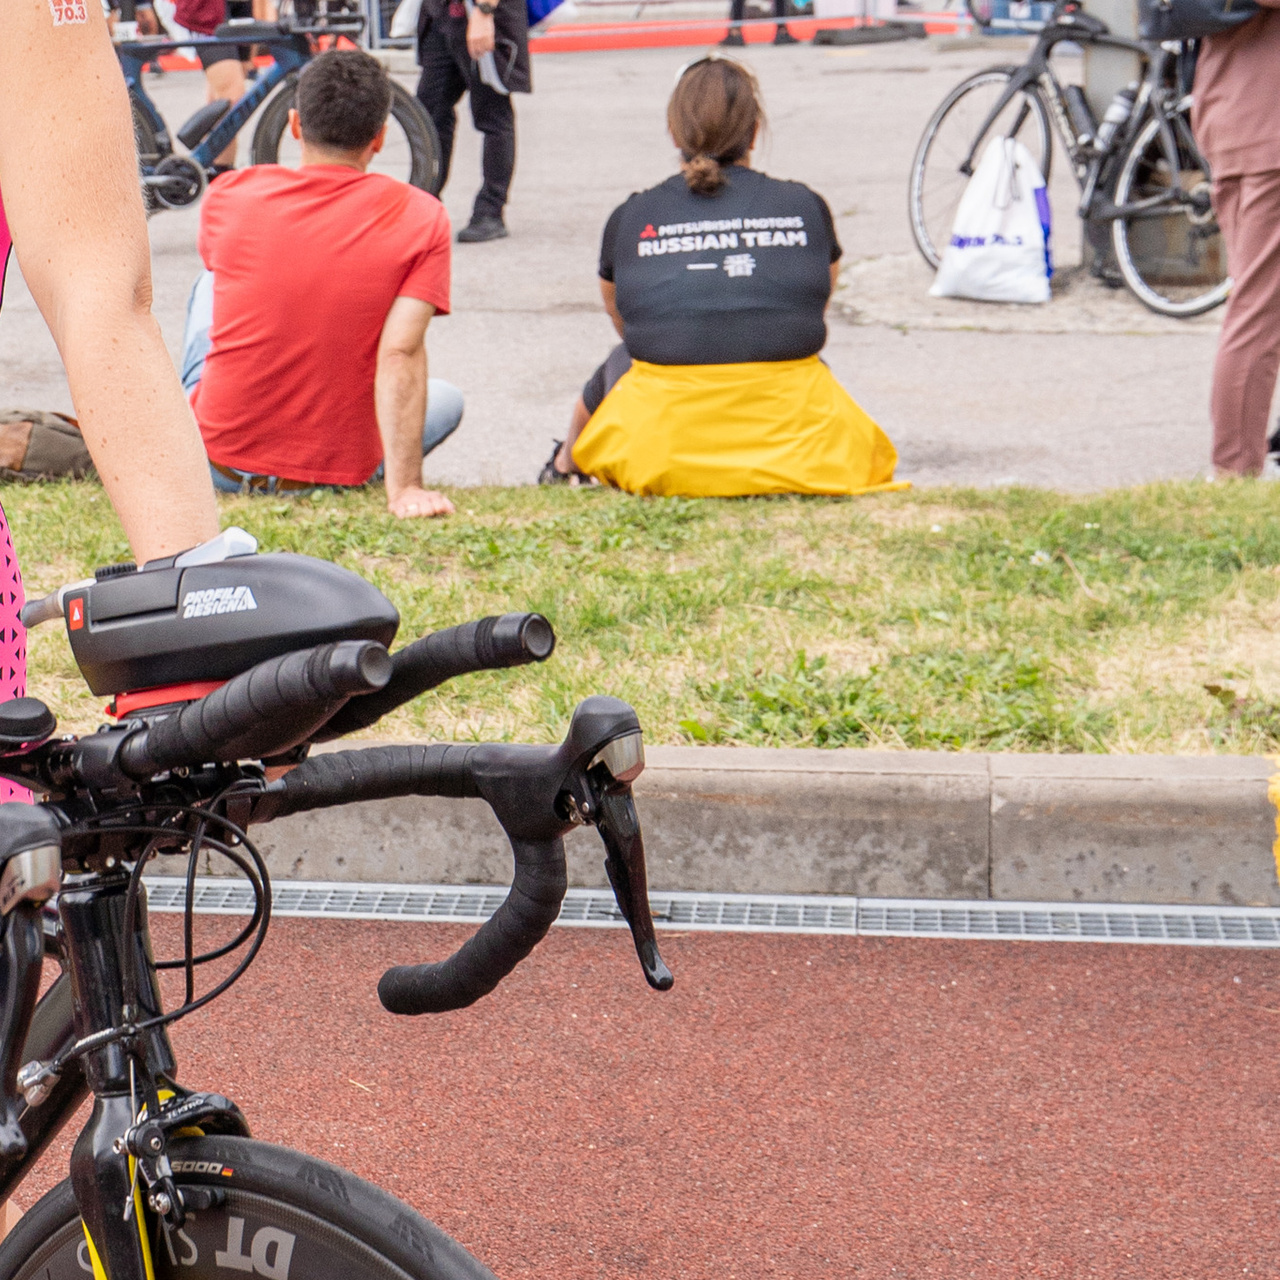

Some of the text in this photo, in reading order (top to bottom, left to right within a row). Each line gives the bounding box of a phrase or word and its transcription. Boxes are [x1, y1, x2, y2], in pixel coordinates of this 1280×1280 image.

[54, 6, 86, 21] 70.3
[658, 216, 804, 237] MITSUBISHI MOTORS
[637, 231, 808, 257] RUSSIAN TEAM
[183, 586, 247, 606] PROFILE
[183, 600, 237, 619] DESIGN
[166, 1098, 205, 1119] TEKTRO
[171, 1161, 223, 1174] 5000
